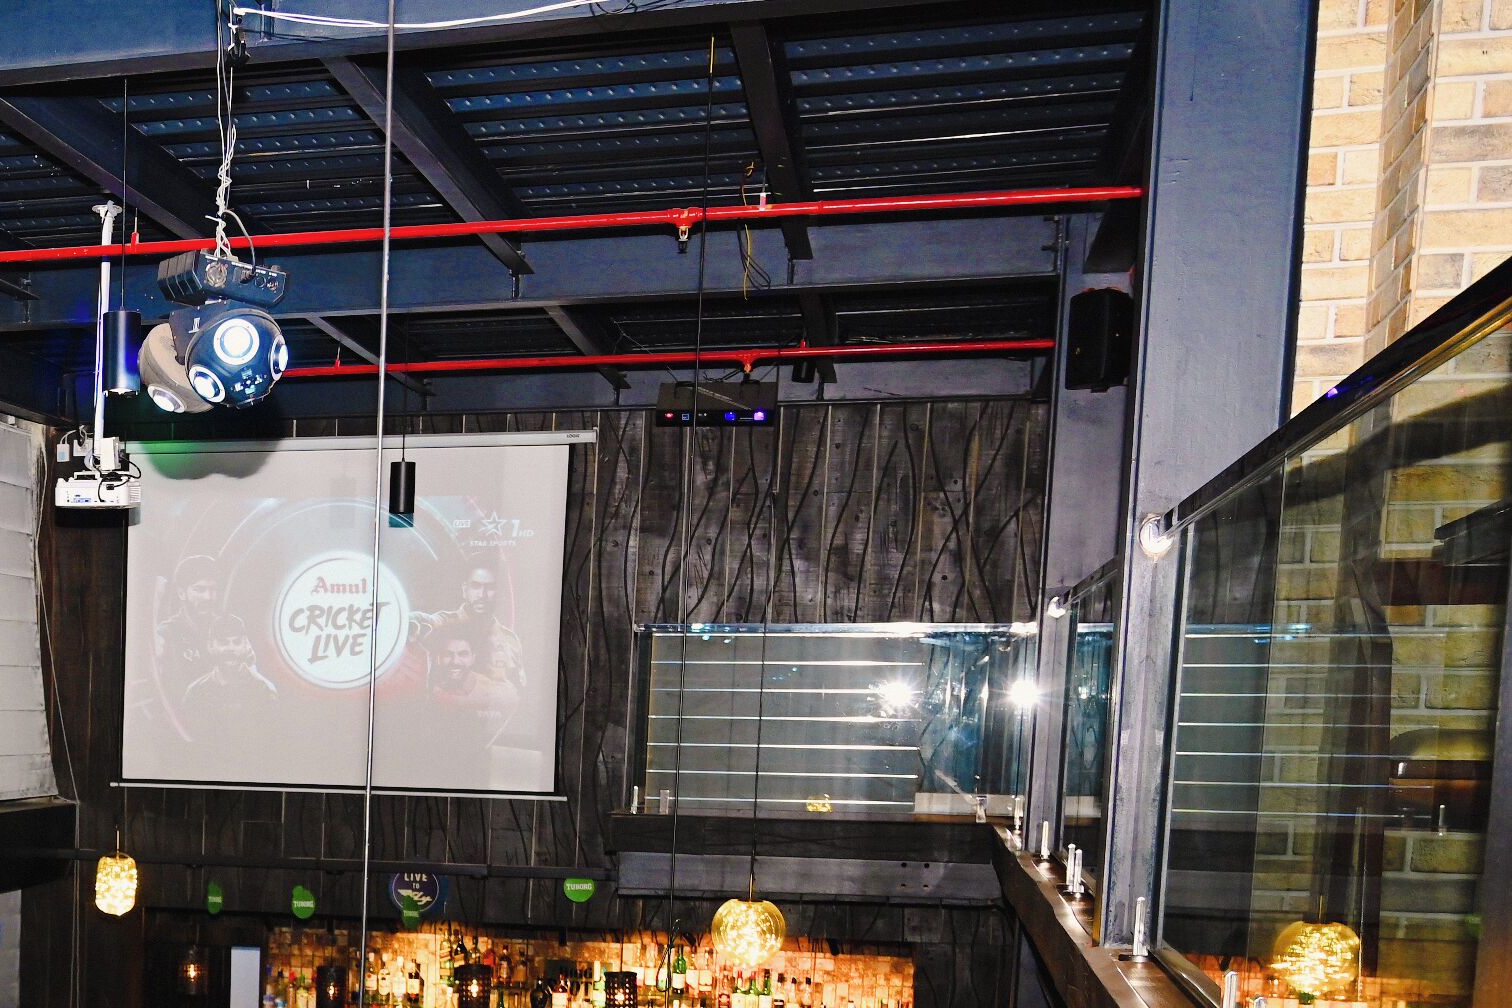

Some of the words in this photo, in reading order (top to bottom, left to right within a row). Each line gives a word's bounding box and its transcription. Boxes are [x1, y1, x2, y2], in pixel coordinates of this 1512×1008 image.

[310, 576, 368, 595] Amul
[288, 602, 392, 635] CRICKET
[307, 633, 367, 664] LIVE
[404, 873, 428, 881] LIVE
